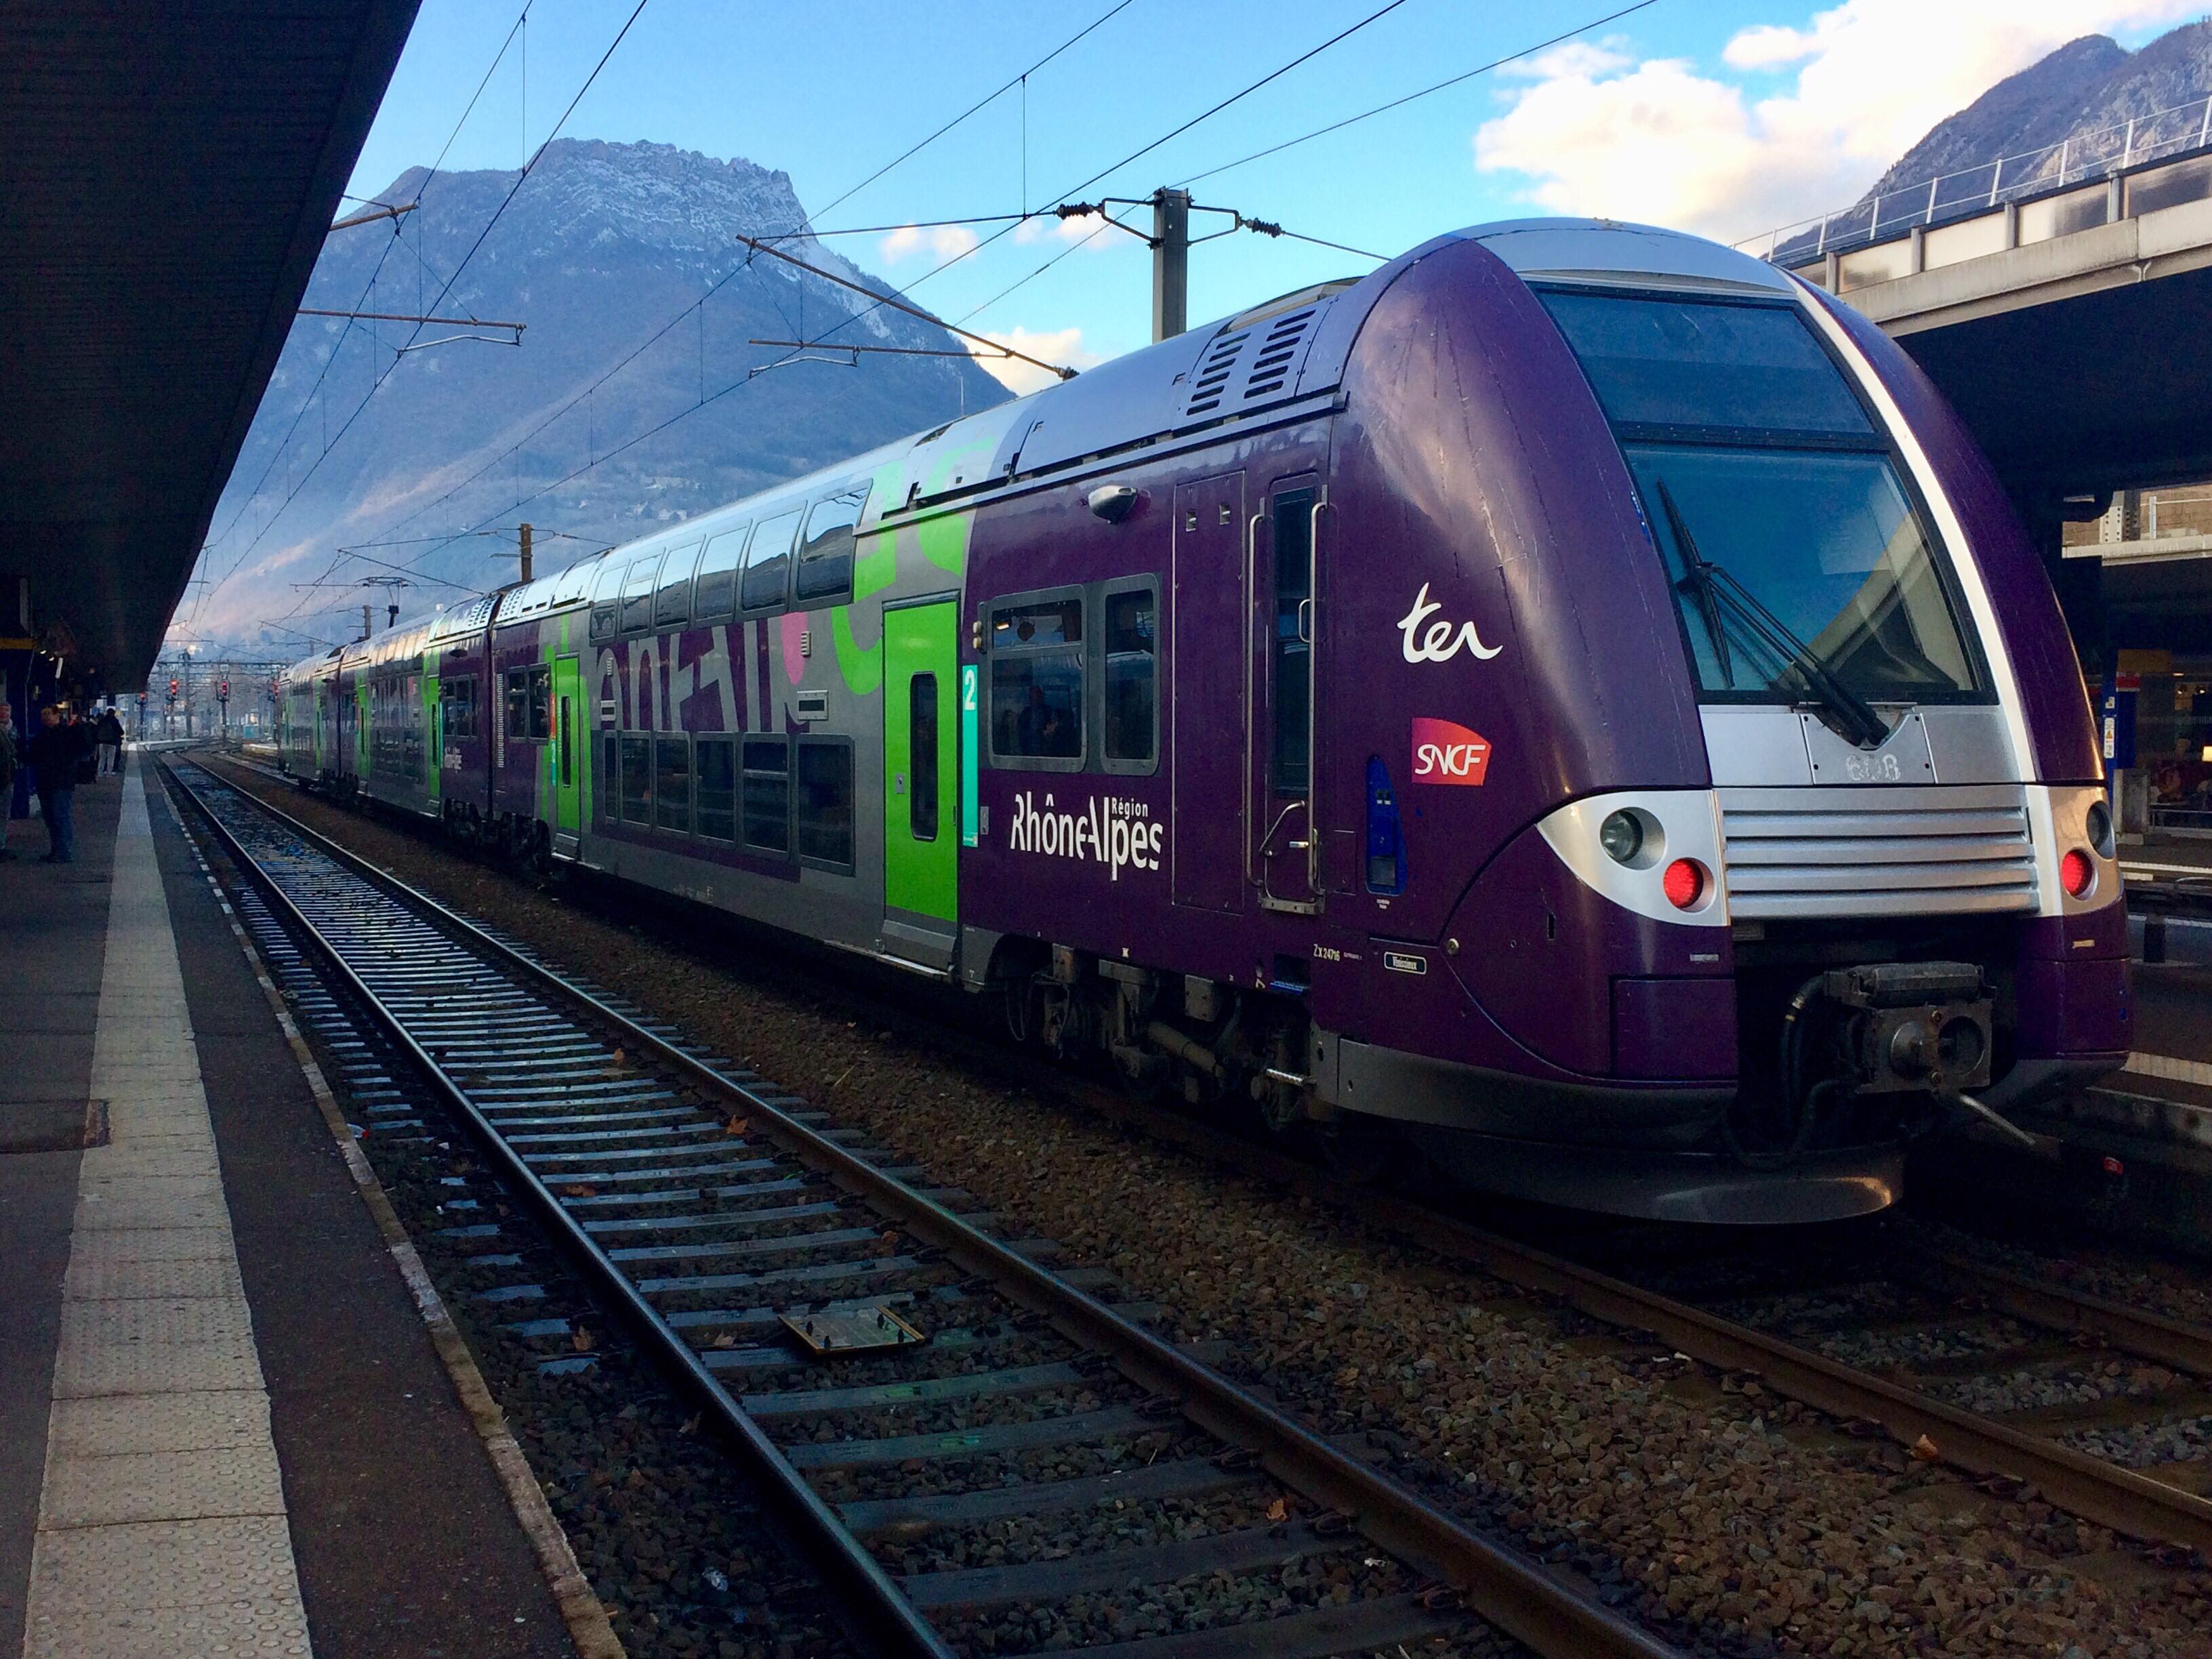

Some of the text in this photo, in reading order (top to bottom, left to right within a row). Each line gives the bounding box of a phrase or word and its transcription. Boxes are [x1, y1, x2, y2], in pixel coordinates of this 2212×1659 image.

[1397, 581, 1503, 664] ter
[964, 669, 976, 711] 2
[1414, 743, 1486, 775] SNCF
[1111, 797, 1149, 820] Région
